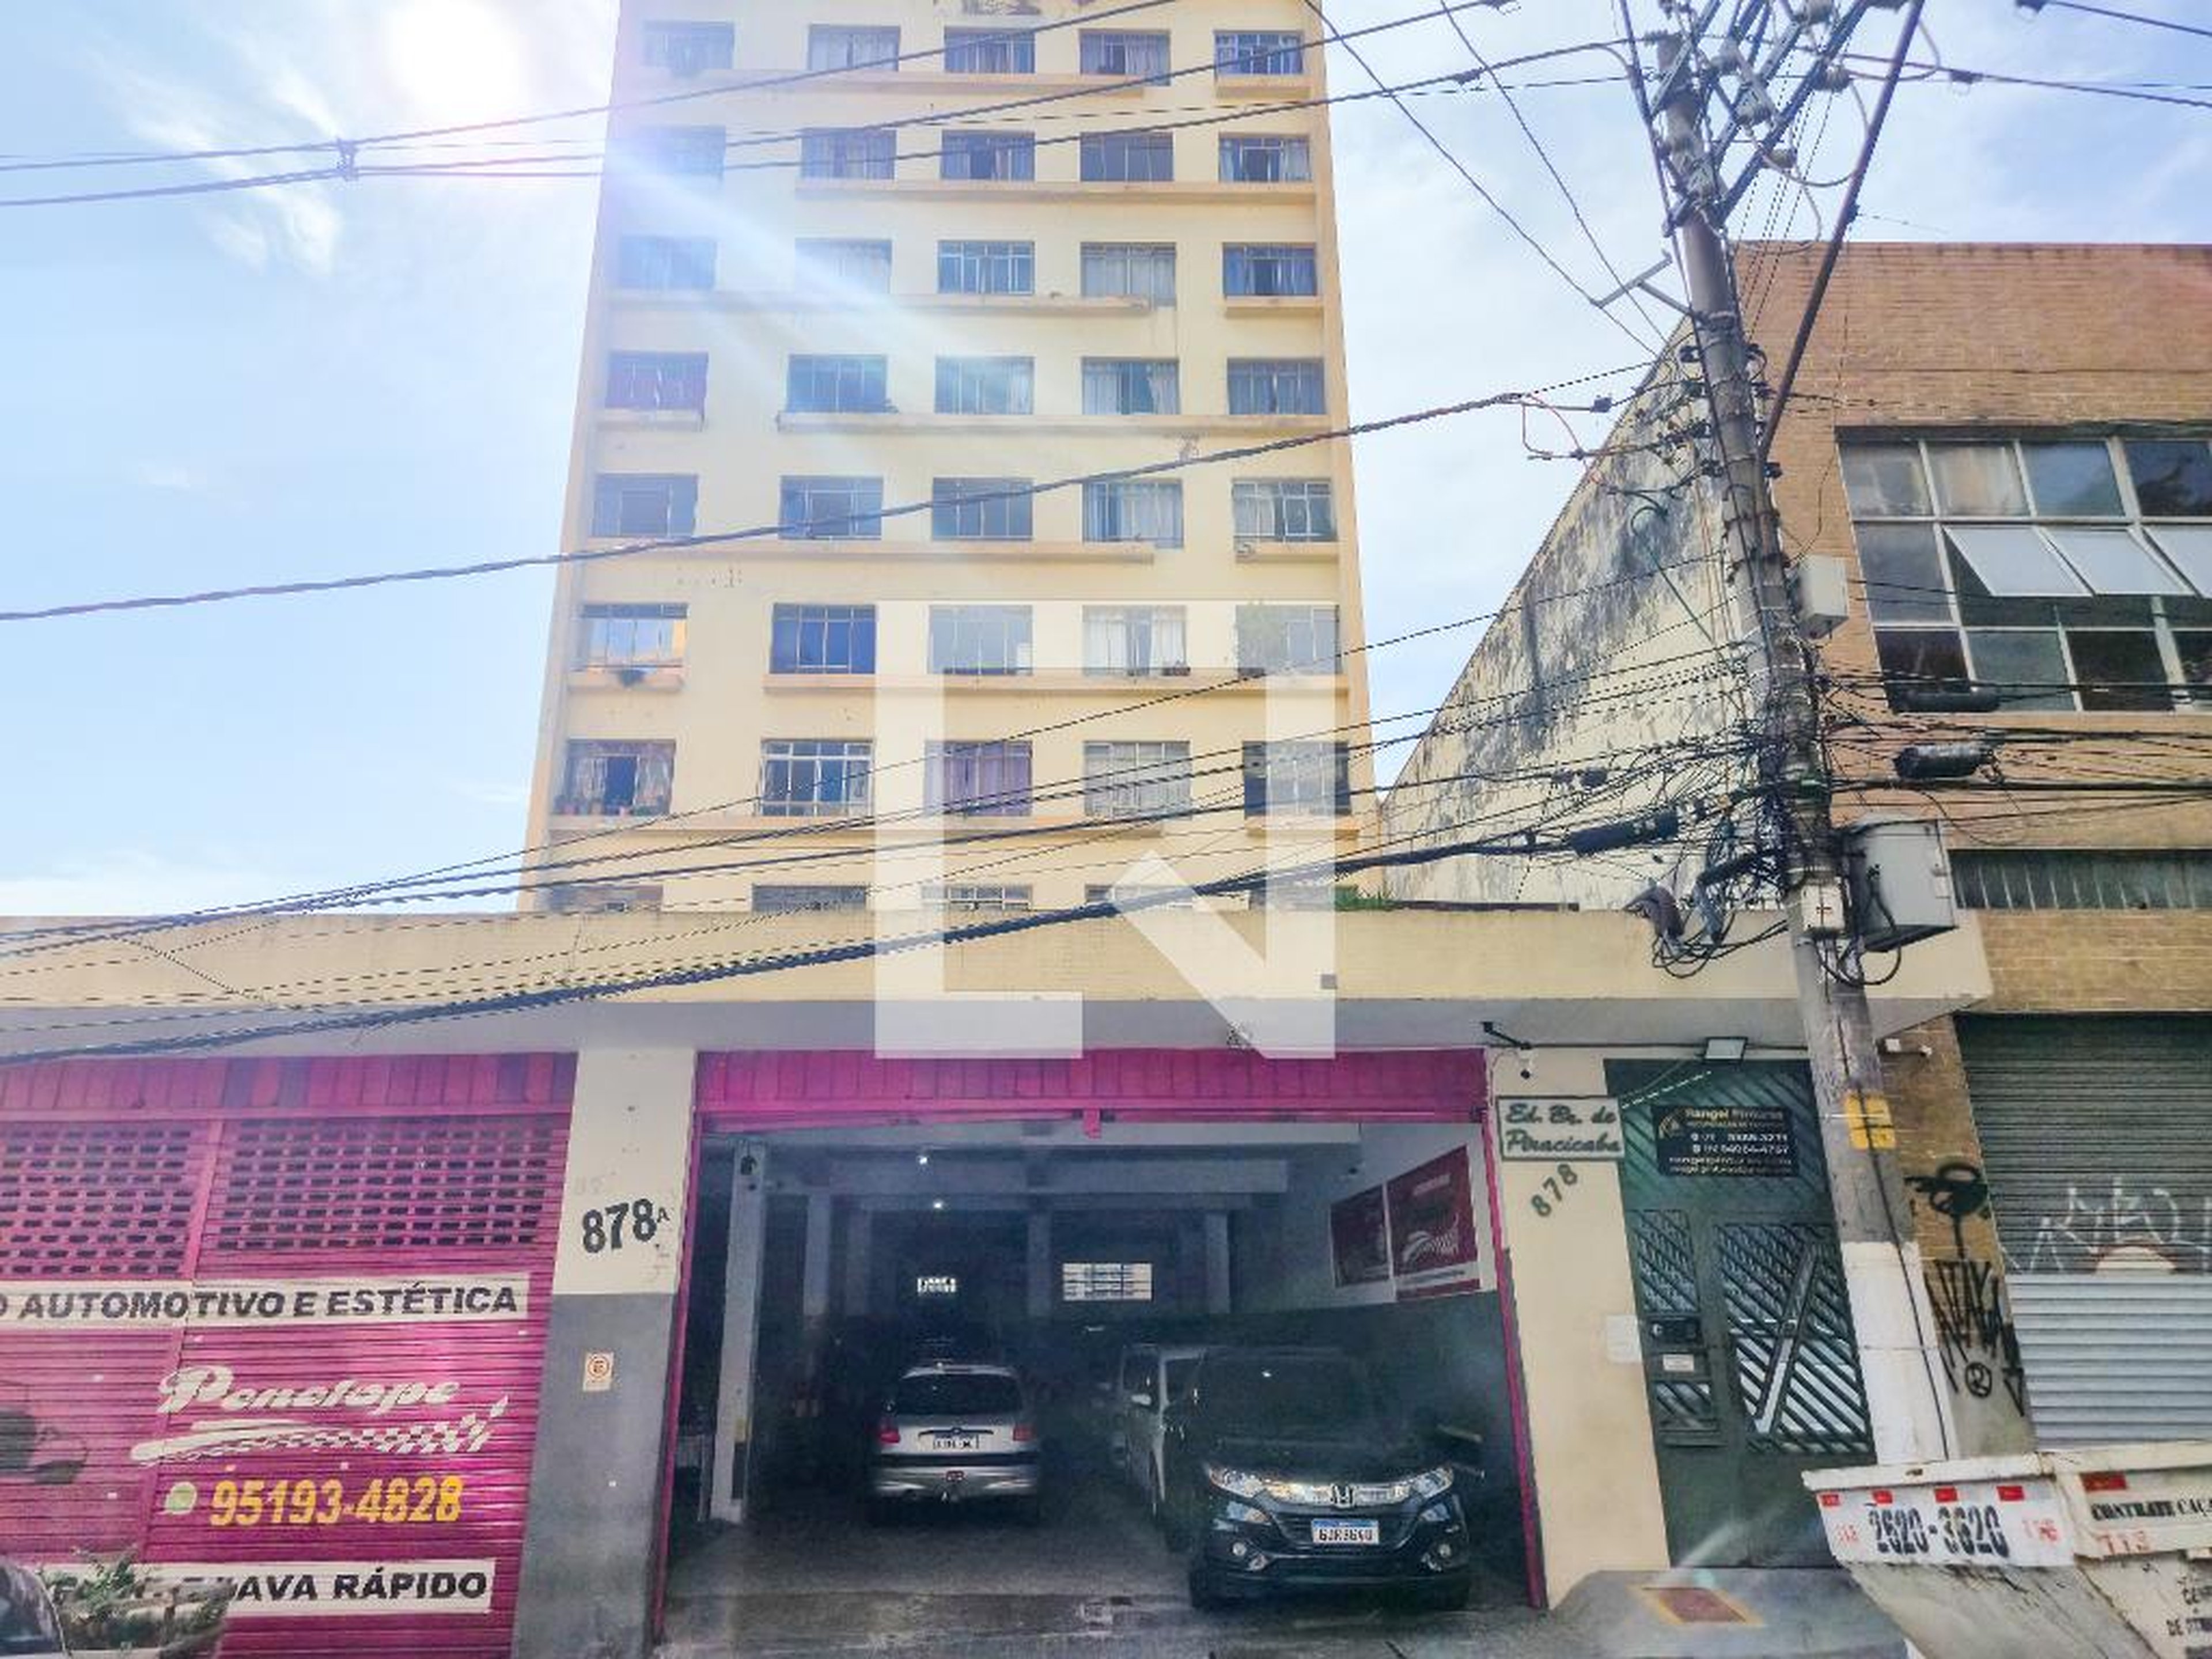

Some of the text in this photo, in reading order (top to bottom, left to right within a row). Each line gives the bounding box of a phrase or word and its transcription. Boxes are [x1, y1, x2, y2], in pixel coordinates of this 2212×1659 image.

[1591, 1105, 1616, 1123] de
[1505, 1129, 1621, 1152] Piracicaba
[1532, 1164, 1578, 1217] 878
[18, 1291, 285, 1319] AUTOMOTIVO
[293, 1291, 318, 1316] E
[326, 1281, 517, 1316] ESTÉTICA
[156, 1366, 460, 1415] Penelope
[210, 1475, 464, 1526] 95193-4828
[1868, 1505, 2009, 1558] 2620-3620
[334, 1567, 487, 1599] RÁPIDO
